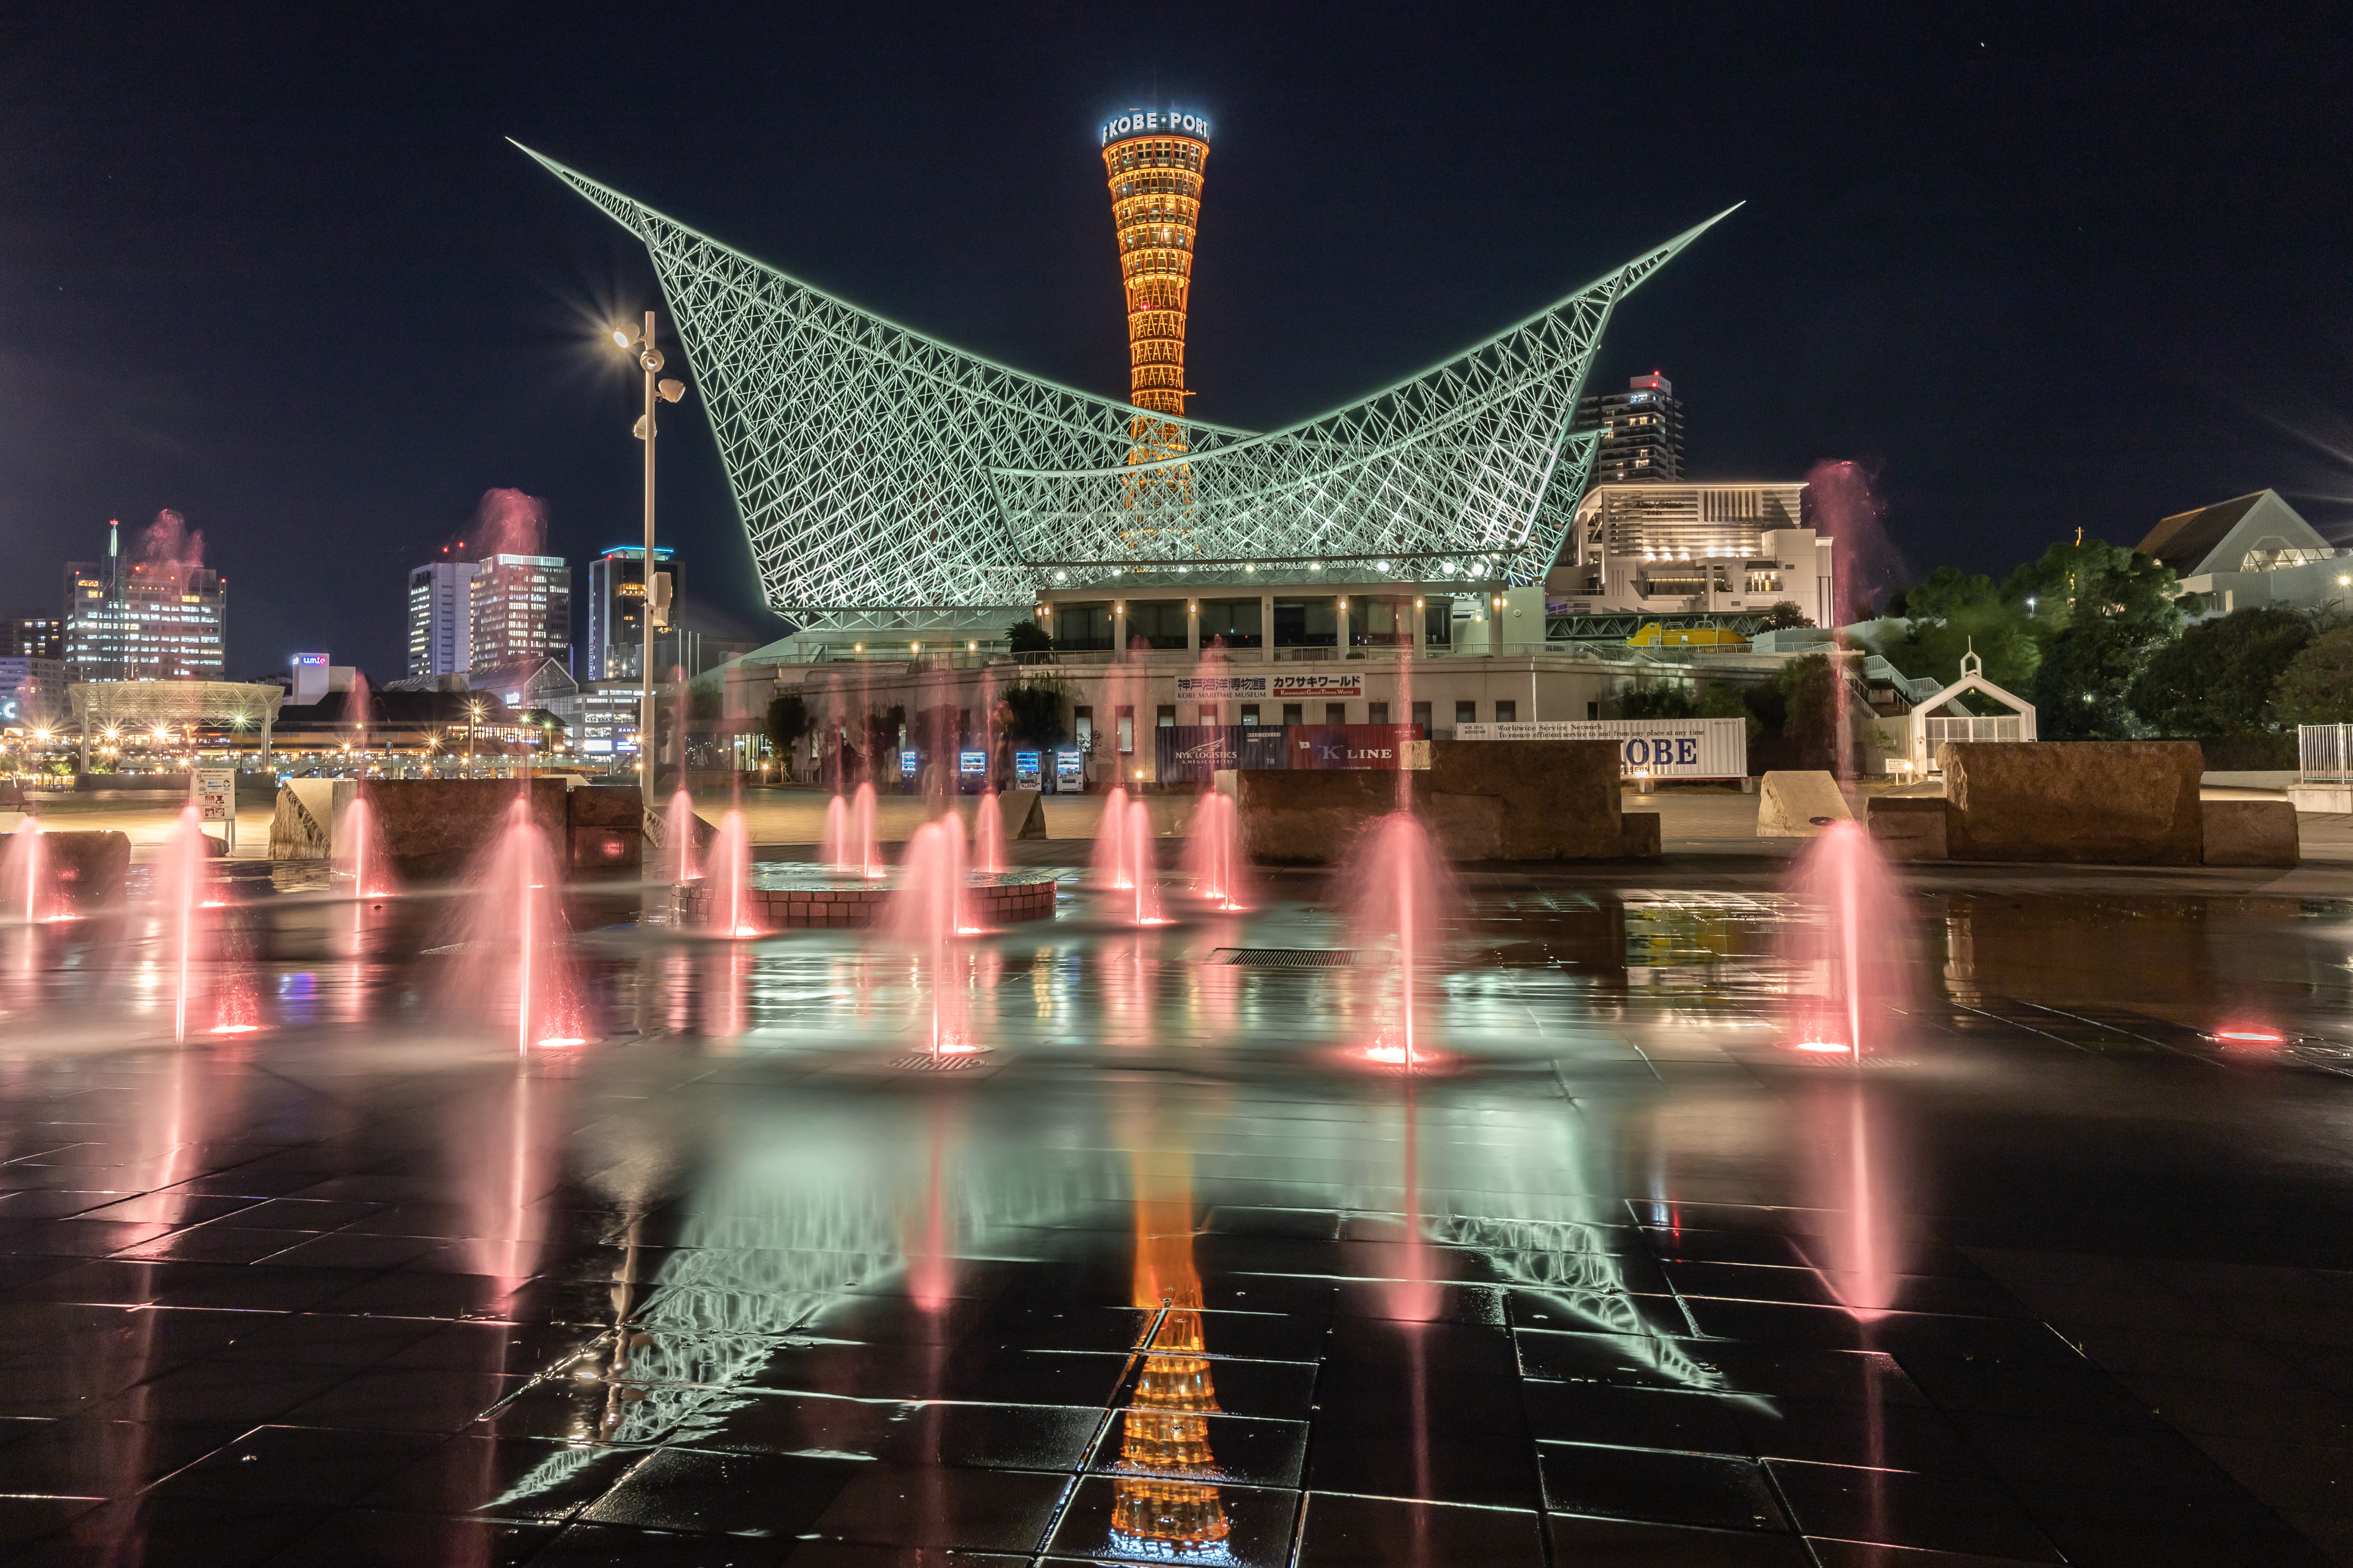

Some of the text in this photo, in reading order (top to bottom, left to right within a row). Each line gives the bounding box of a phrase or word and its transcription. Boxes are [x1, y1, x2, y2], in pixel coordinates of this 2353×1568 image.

[1109, 112, 1157, 138] KOBE
[1170, 112, 1207, 138] PORT
[303, 656, 326, 665] umie
[1178, 678, 1266, 691] 神戸海洋博物館
[1274, 676, 1361, 688] カワサキワールド
[1347, 749, 1392, 759] LINE
[1620, 738, 1697, 765] OBE
